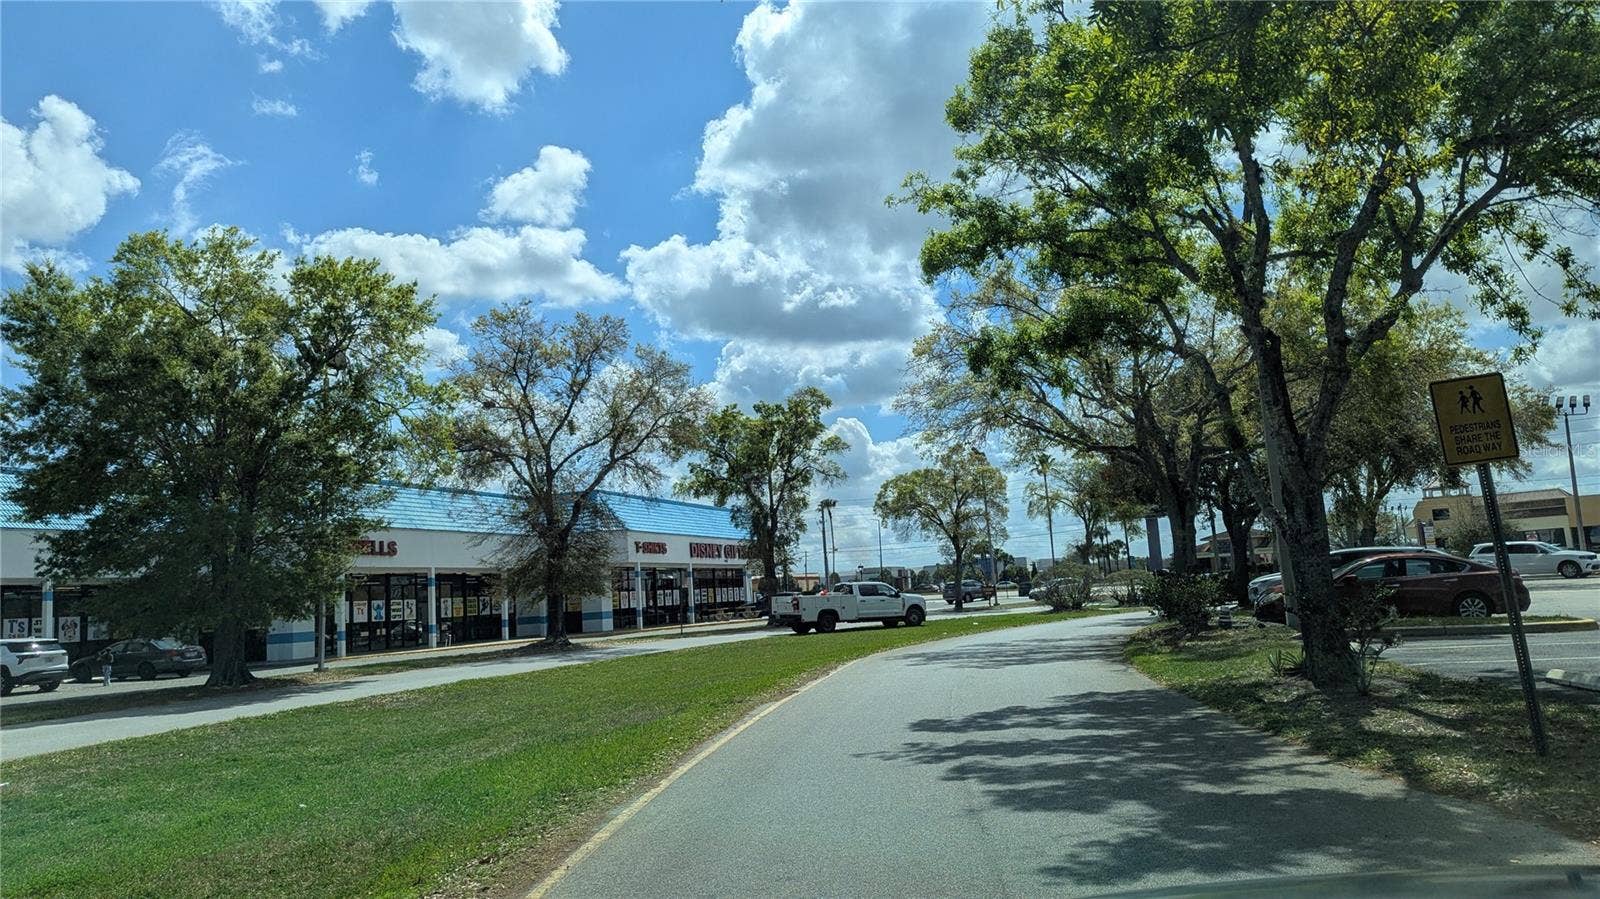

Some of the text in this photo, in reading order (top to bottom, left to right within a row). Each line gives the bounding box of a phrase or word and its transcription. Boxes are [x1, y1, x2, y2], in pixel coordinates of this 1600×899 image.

[1449, 419, 1502, 434] PEDESTRIANS
[1454, 430, 1501, 445] SHARE THE
[1456, 440, 1503, 456] ROAD WAY
[634, 541, 667, 555] T-SHIRTS
[689, 542, 722, 559] DISNEY
